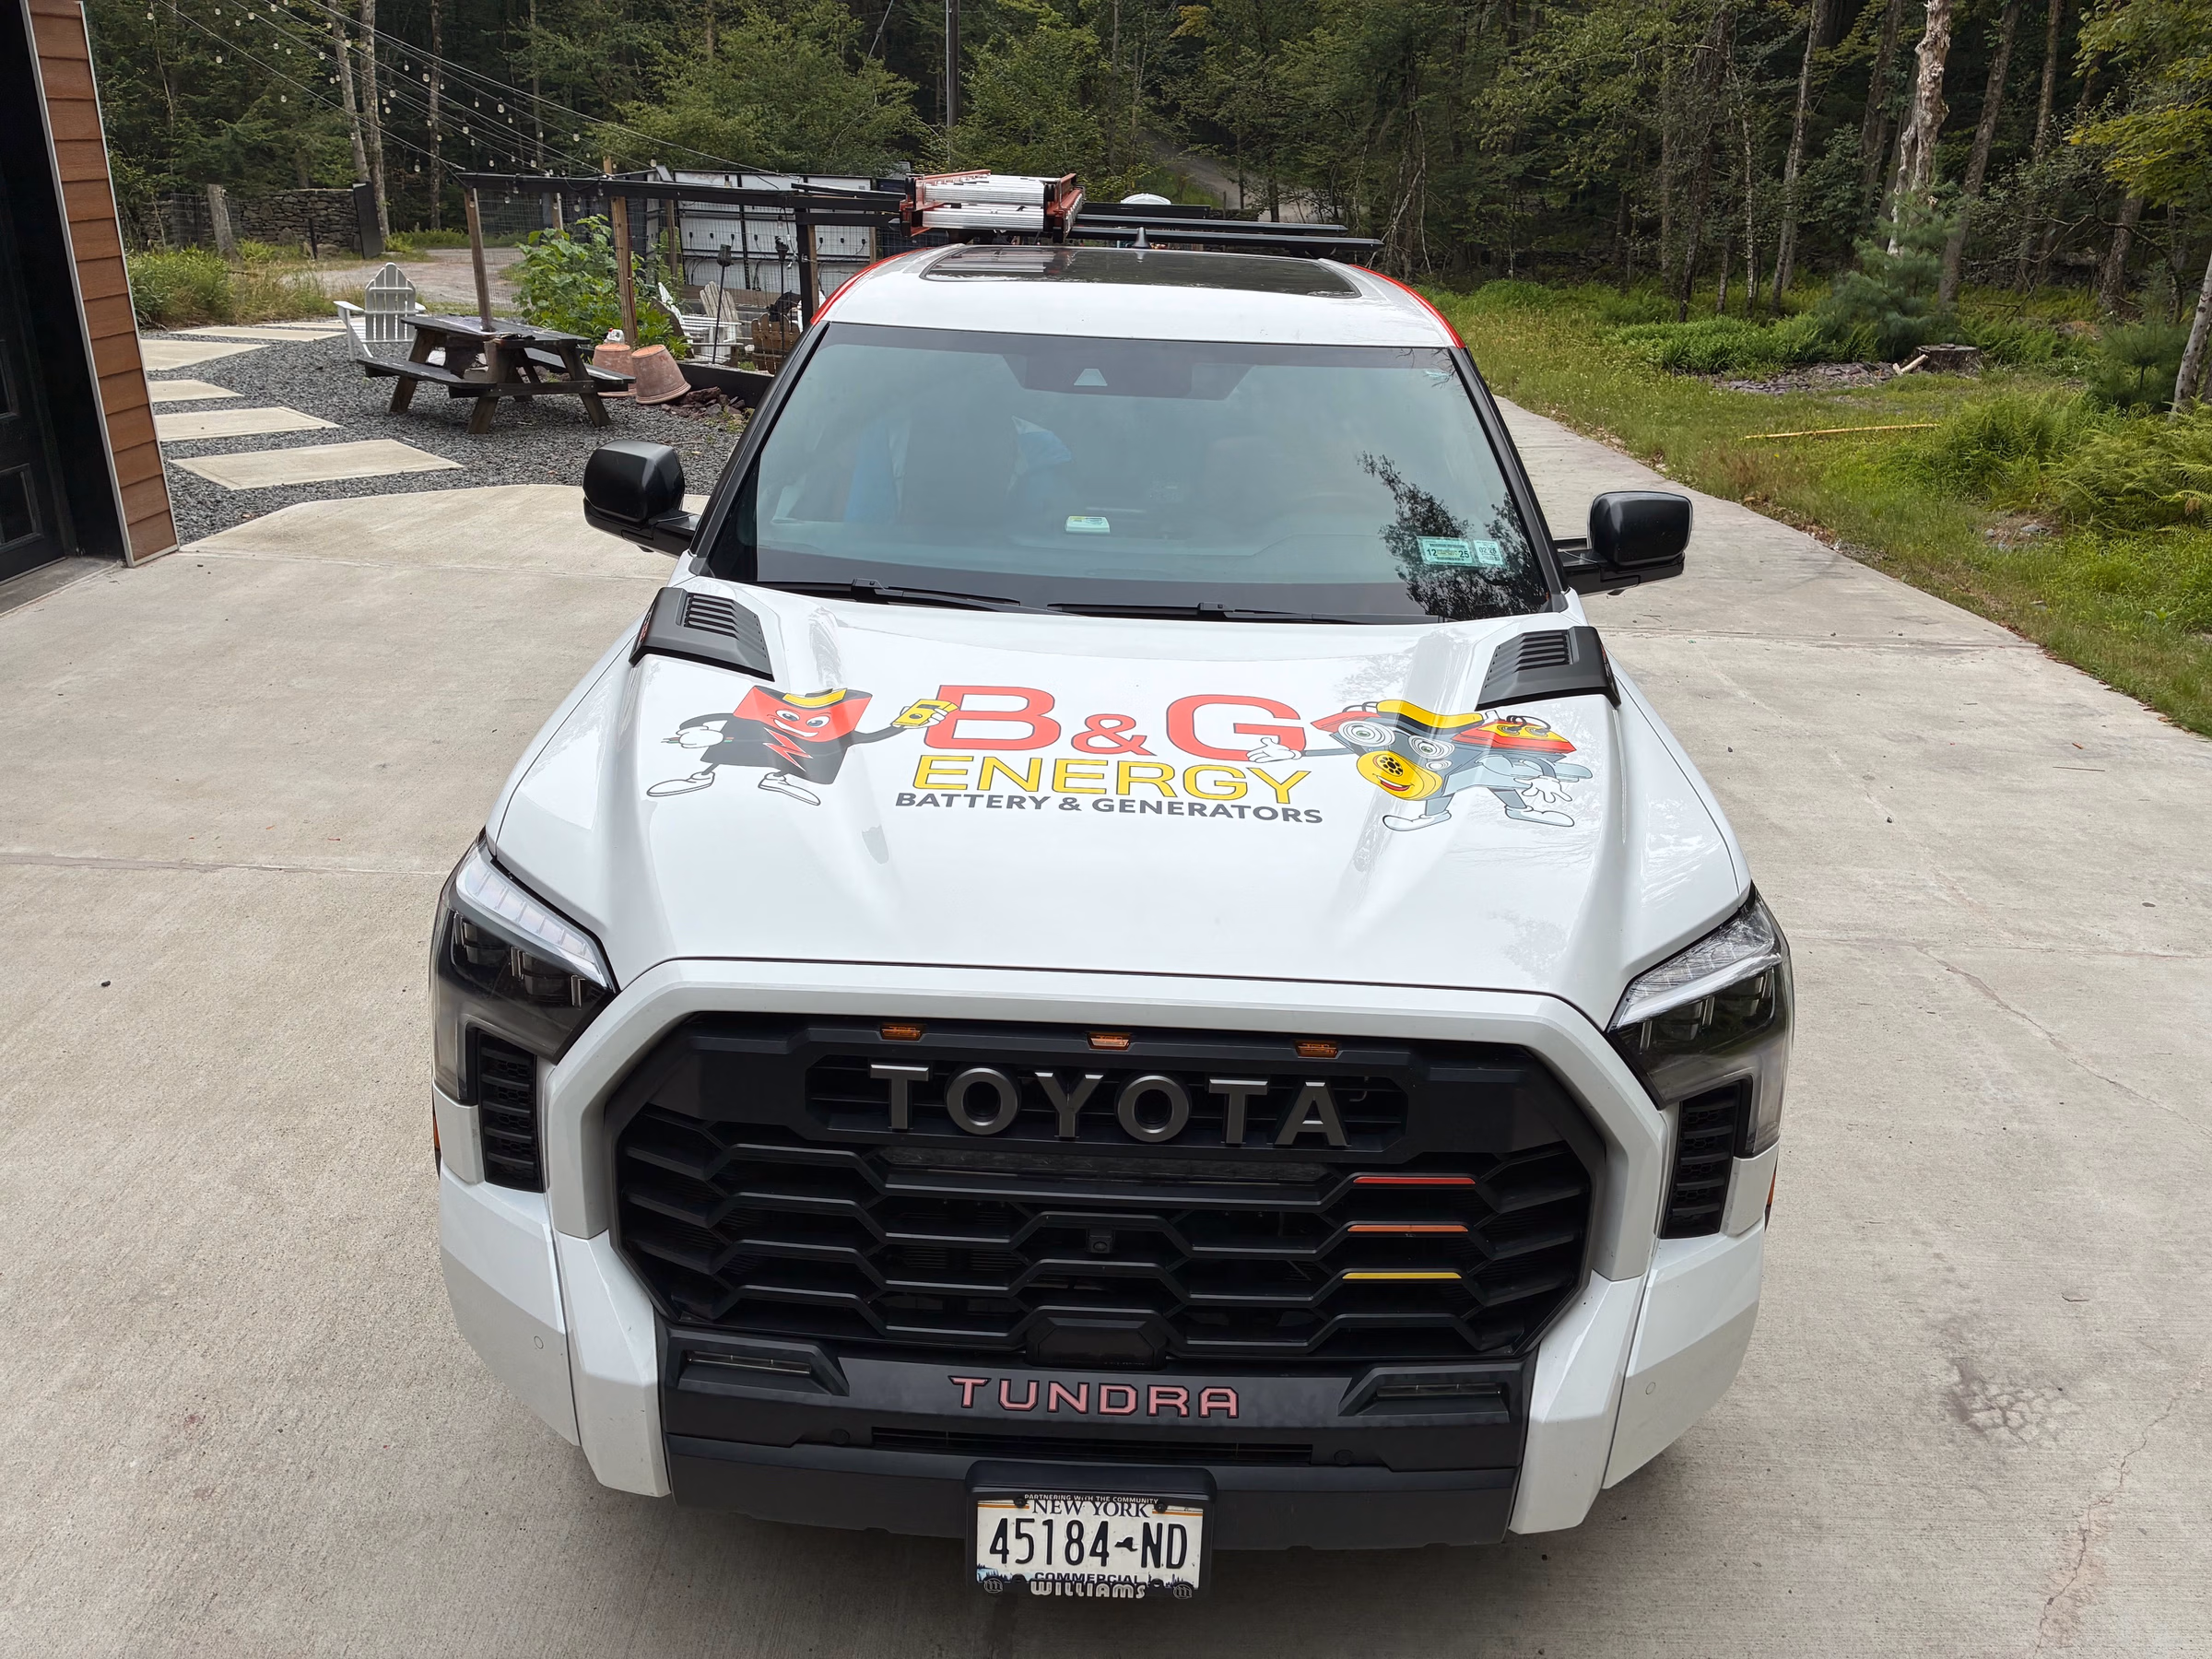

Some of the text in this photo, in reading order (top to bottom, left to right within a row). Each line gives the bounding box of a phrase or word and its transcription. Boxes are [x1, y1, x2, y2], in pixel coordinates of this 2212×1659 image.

[1426, 548, 1470, 559] 12 25
[912, 755, 1312, 805] ENERGY
[895, 792, 1324, 824] BATTERY & GENERATORS
[869, 1062, 1349, 1147] TOYOTA
[949, 1376, 1240, 1419] TUNDRA
[1024, 1493, 1071, 1501] PARTNERING
[1112, 1496, 1159, 1504] COMMUNITY
[1032, 1500, 1151, 1518] NEW YORK
[989, 1518, 1188, 1570] 45184 ND
[1034, 1571, 1139, 1584] COMMERCIAL
